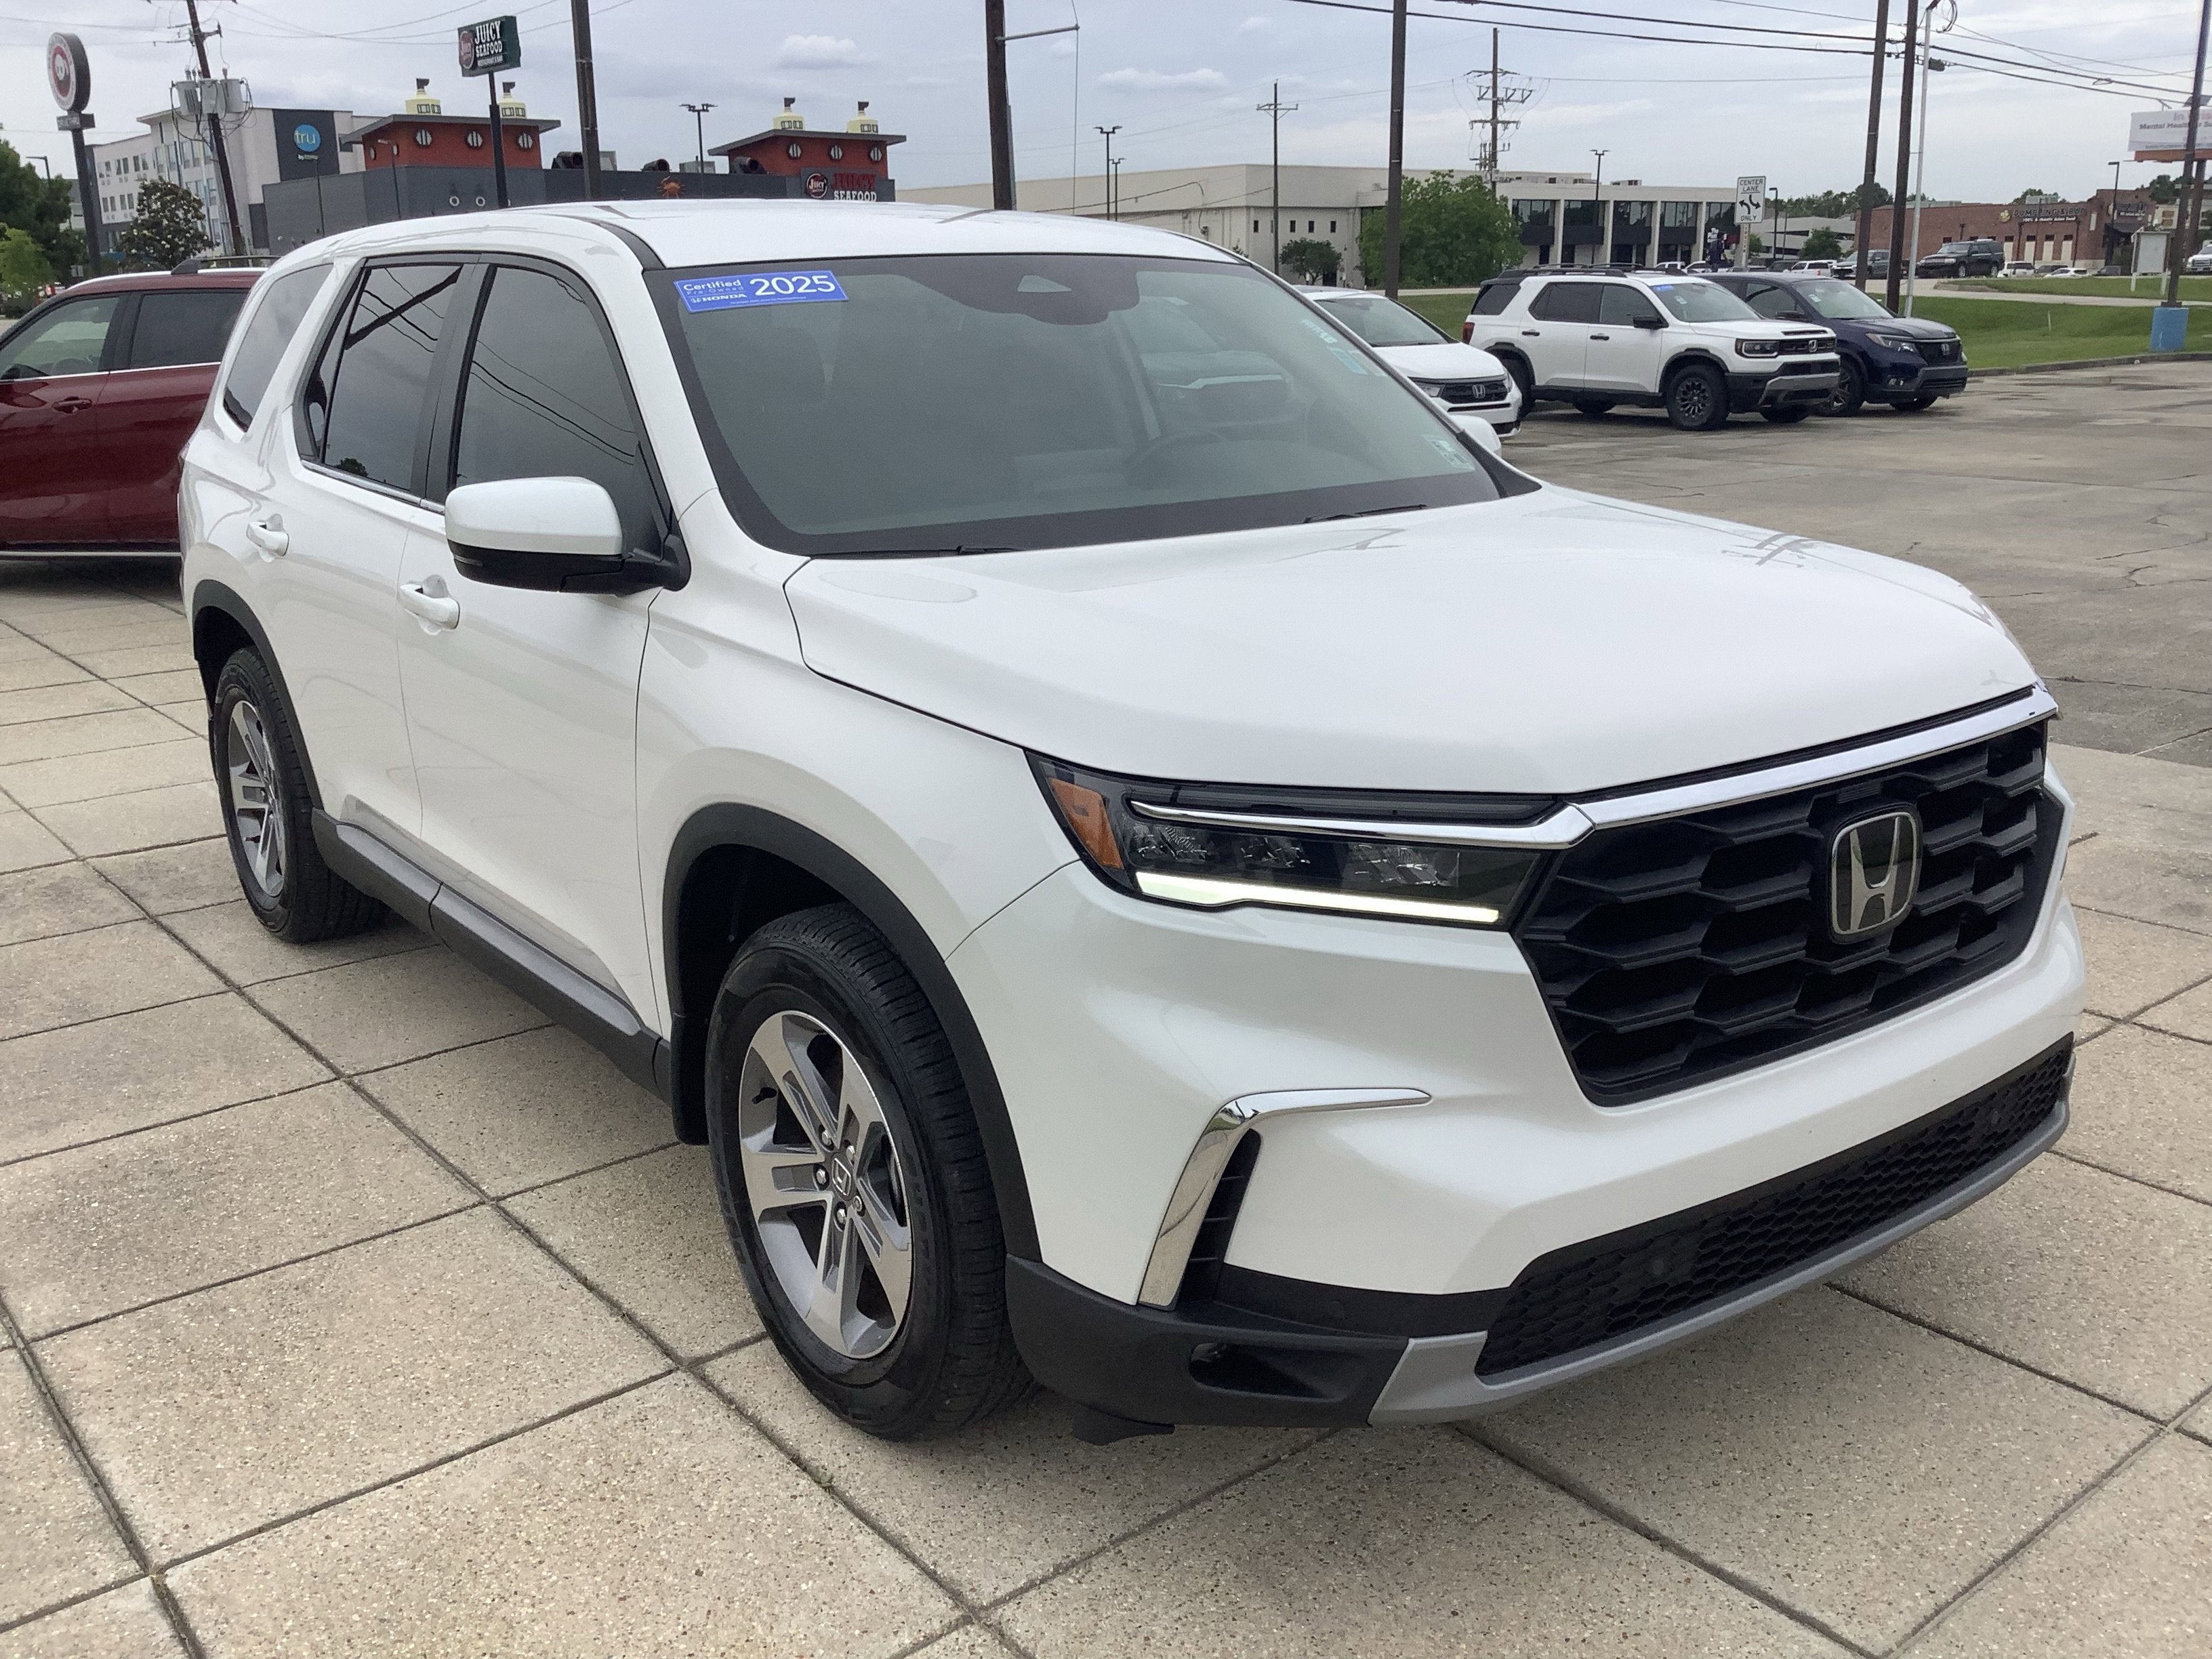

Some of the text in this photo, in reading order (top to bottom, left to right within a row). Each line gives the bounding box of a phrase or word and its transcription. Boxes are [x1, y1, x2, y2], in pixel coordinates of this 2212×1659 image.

[474, 21, 501, 45] JUICY
[476, 41, 503, 58] SEAFOOD
[294, 131, 315, 144] tru
[834, 190, 877, 202] SEAFOOD
[683, 279, 741, 291] Certified
[750, 275, 836, 296] 2025
[702, 293, 747, 302] HONDA
